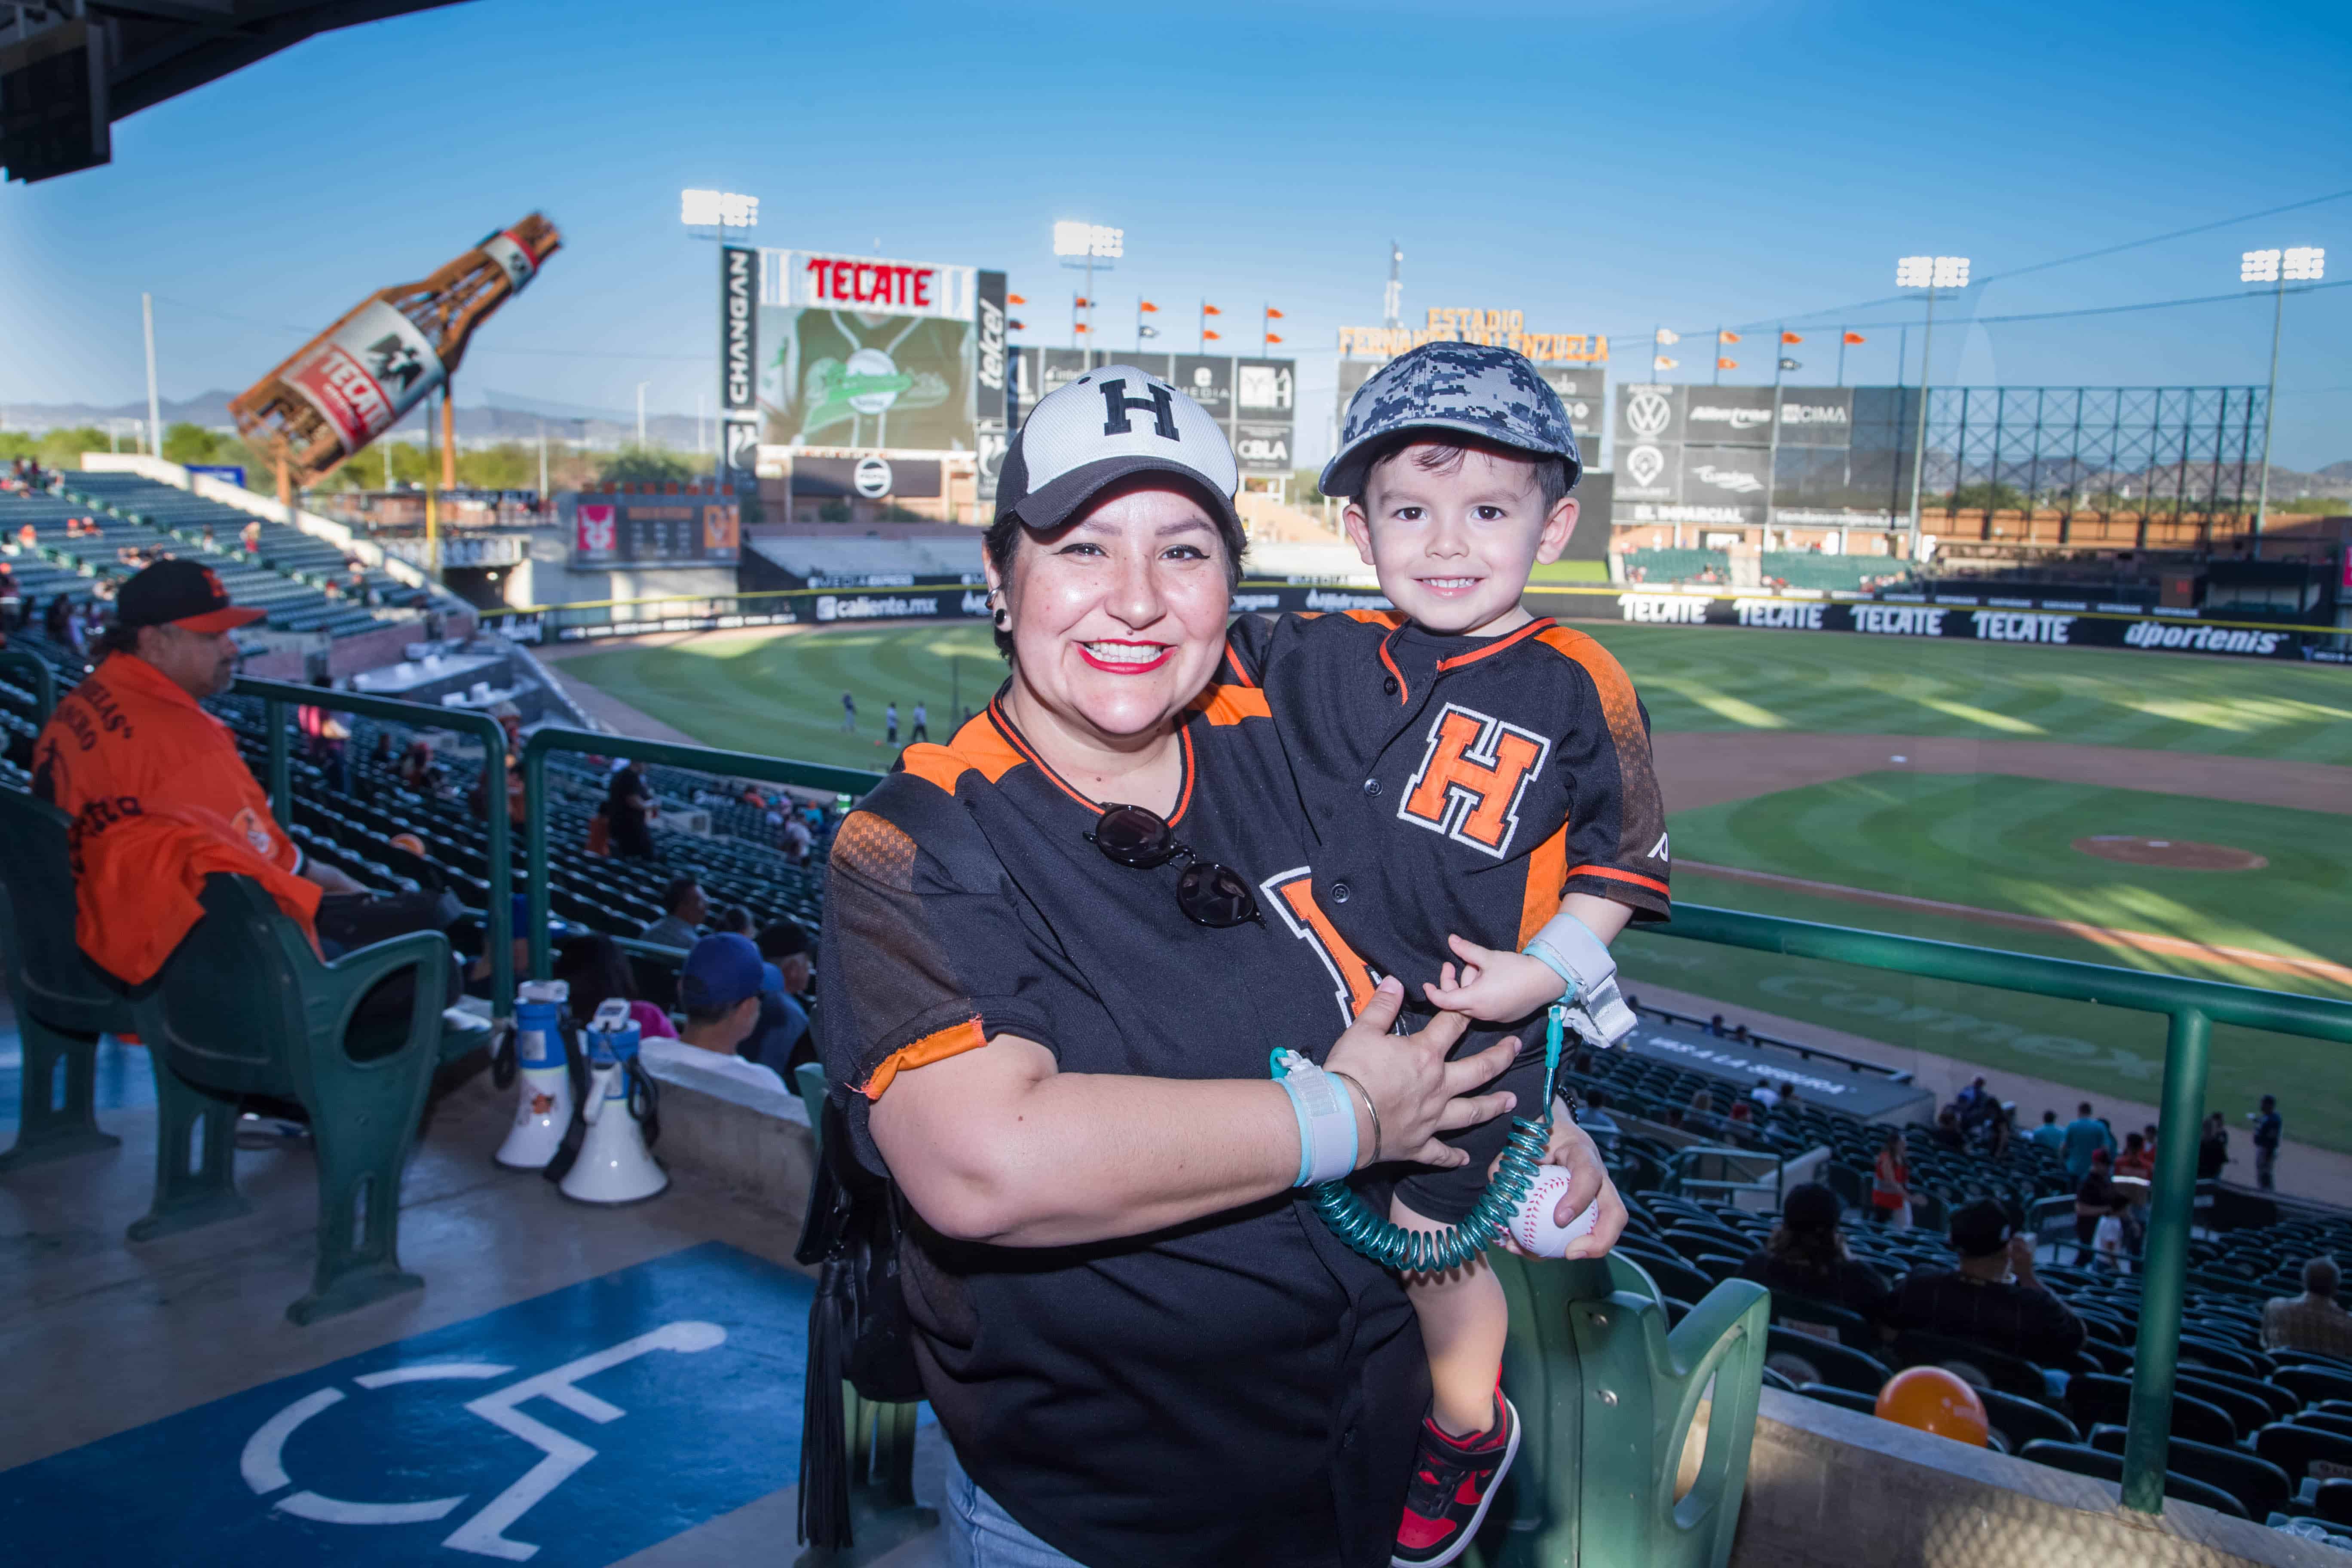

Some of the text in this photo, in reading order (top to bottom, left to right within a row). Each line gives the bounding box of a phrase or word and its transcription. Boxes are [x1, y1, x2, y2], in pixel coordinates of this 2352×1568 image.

[807, 258, 934, 307] TECATE
[729, 251, 750, 404] CHANGAN
[1427, 308, 1524, 333] ESTADIO
[979, 298, 1005, 390] telcel
[1099, 378, 1180, 442] H
[1801, 405, 1847, 423] CIMA
[837, 596, 937, 618] caliente.mx
[1617, 594, 1714, 624] TECATE
[1732, 598, 1831, 630] TECATE
[1850, 604, 1950, 635] TECATE
[1971, 610, 2077, 643] TECATE
[2124, 621, 2278, 655] dportenis
[1398, 702, 1551, 860] H
